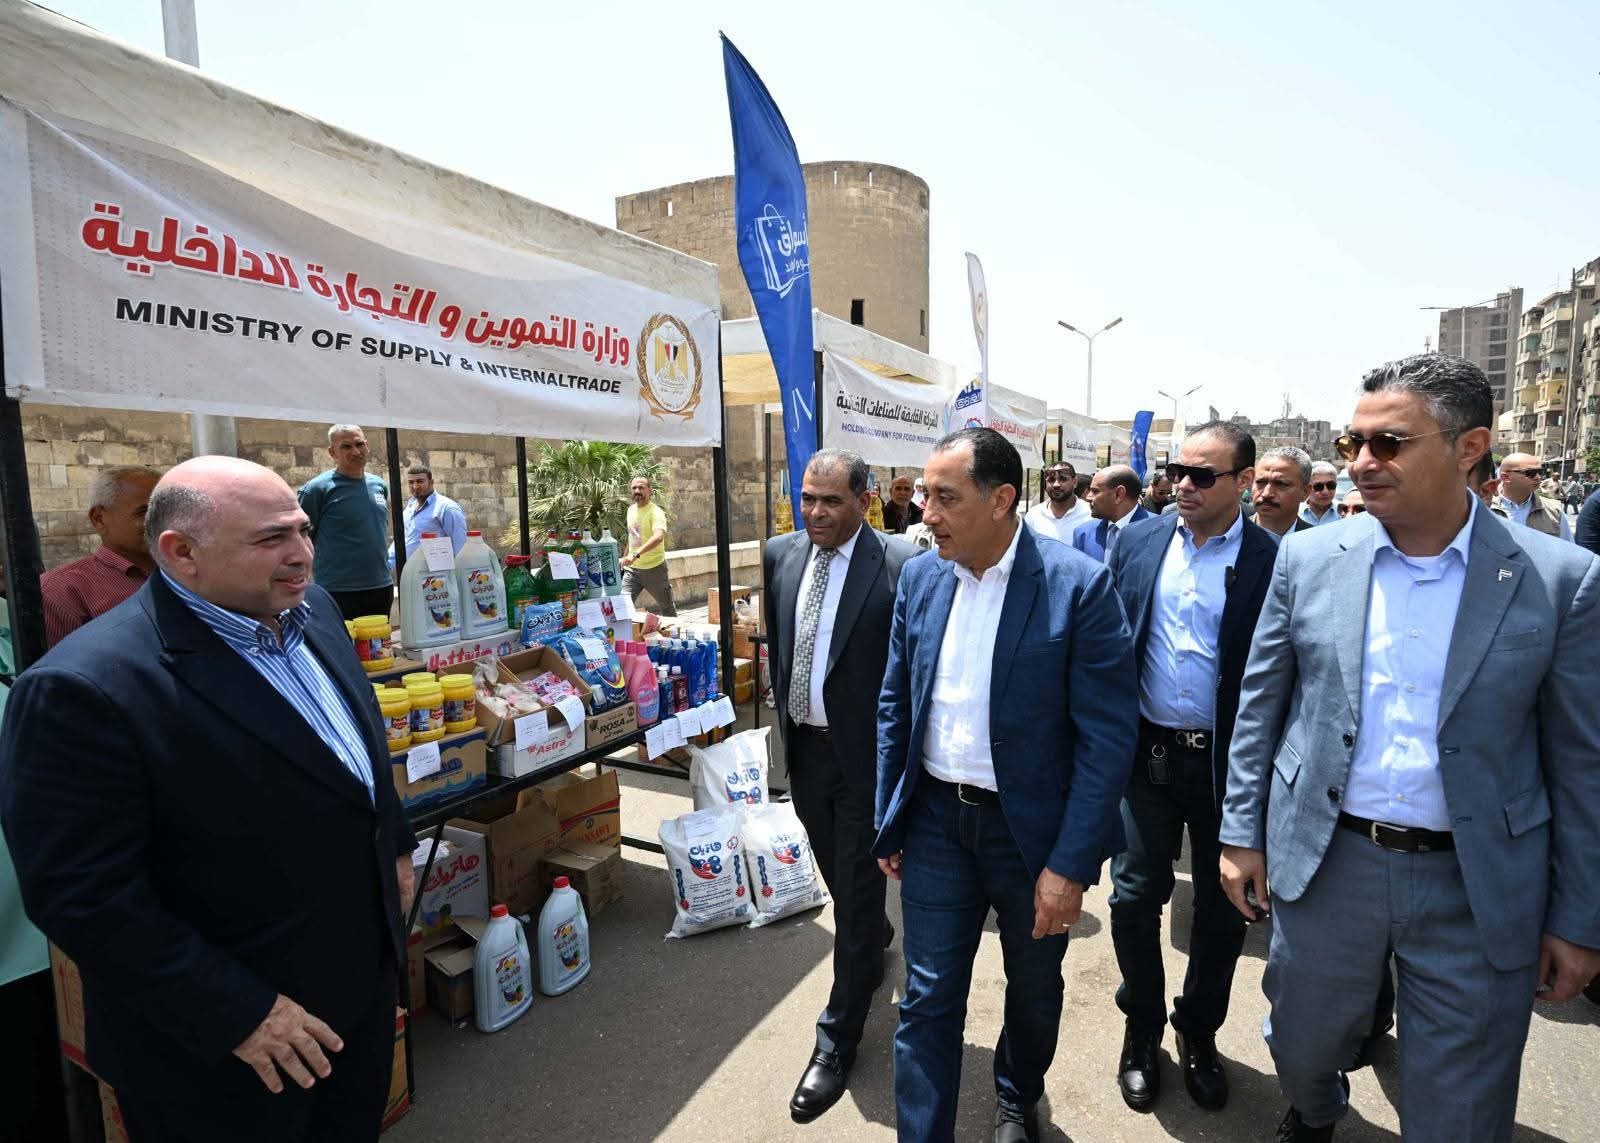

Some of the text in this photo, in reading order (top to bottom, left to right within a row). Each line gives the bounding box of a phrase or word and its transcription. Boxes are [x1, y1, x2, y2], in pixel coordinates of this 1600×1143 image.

[82, 203, 630, 366] وزارة التموين و التجارة الداخلية
[115, 298, 303, 343] MINISTRY
[311, 329, 352, 351] OF
[360, 336, 452, 367] SUPPLY
[460, 357, 473, 372] &
[892, 432, 903, 441] FOR
[903, 433, 917, 443] FOOD
[600, 718, 625, 734] ROSA
[536, 739, 566, 756] Astra
